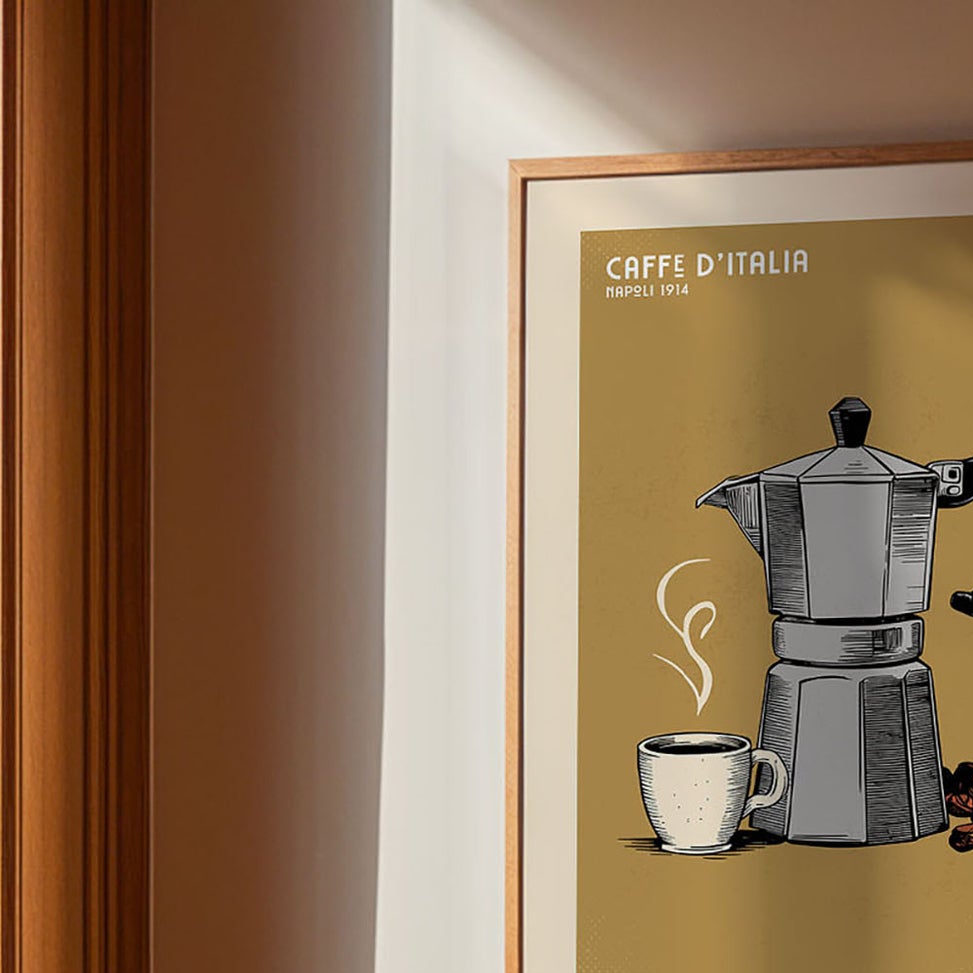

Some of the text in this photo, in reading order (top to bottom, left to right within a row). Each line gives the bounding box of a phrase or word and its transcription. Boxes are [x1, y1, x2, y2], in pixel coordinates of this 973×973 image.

[606, 249, 808, 280] CAFFE D'ITALIA
[606, 283, 689, 298] NAPOLI 1914
